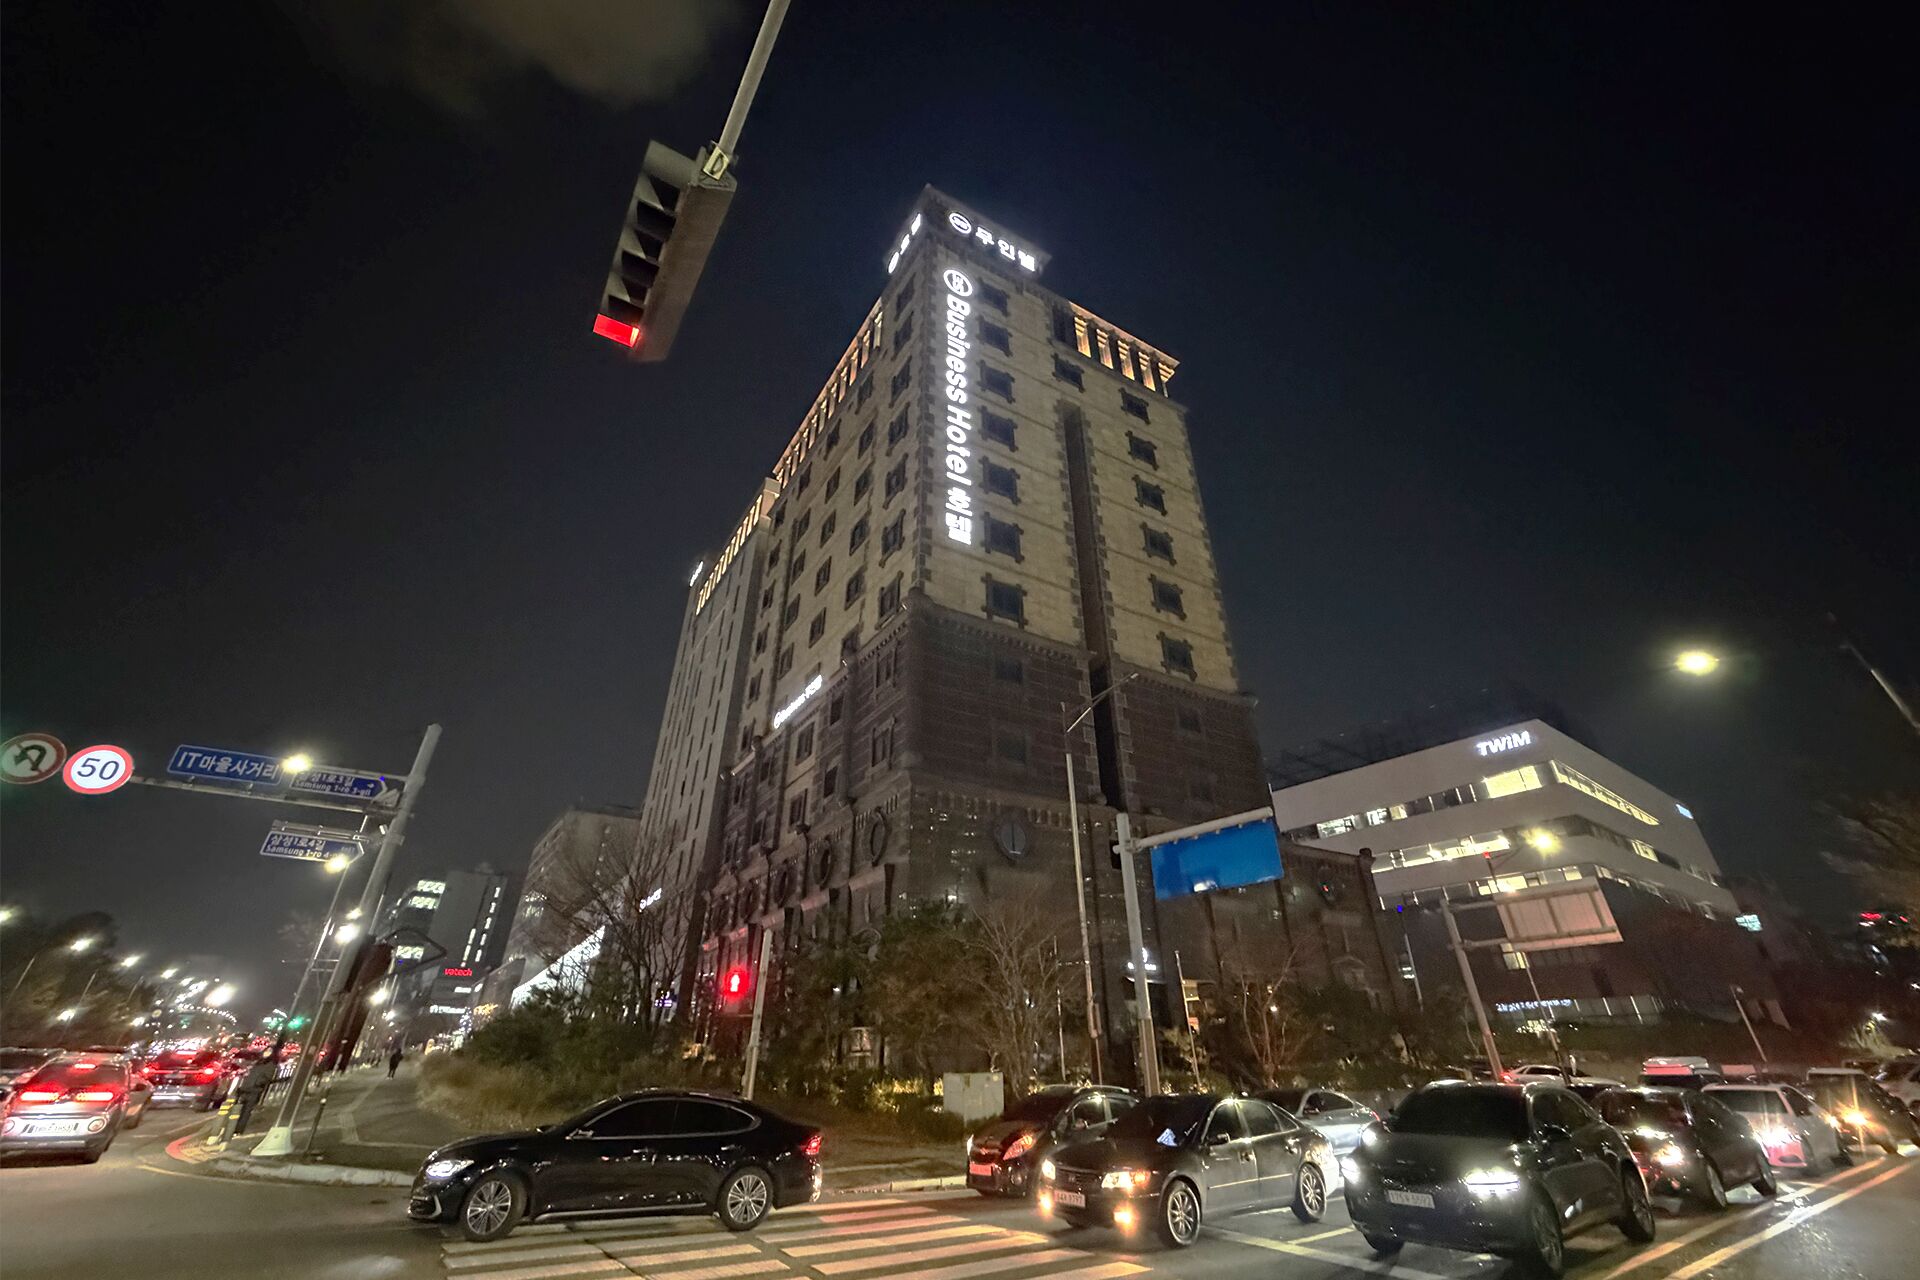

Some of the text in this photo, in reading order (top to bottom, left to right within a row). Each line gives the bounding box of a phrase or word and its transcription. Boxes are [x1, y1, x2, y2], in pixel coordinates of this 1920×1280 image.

[946, 294, 971, 404] Business
[946, 404, 972, 486] Hotel
[77, 757, 120, 780] 50
[176, 751, 280, 780] IT마을사거리
[295, 780, 331, 792] Samsung
[266, 845, 304, 857] Samsung
[306, 849, 322, 858] 1-ro
[271, 834, 326, 851] 삼성1로4길
